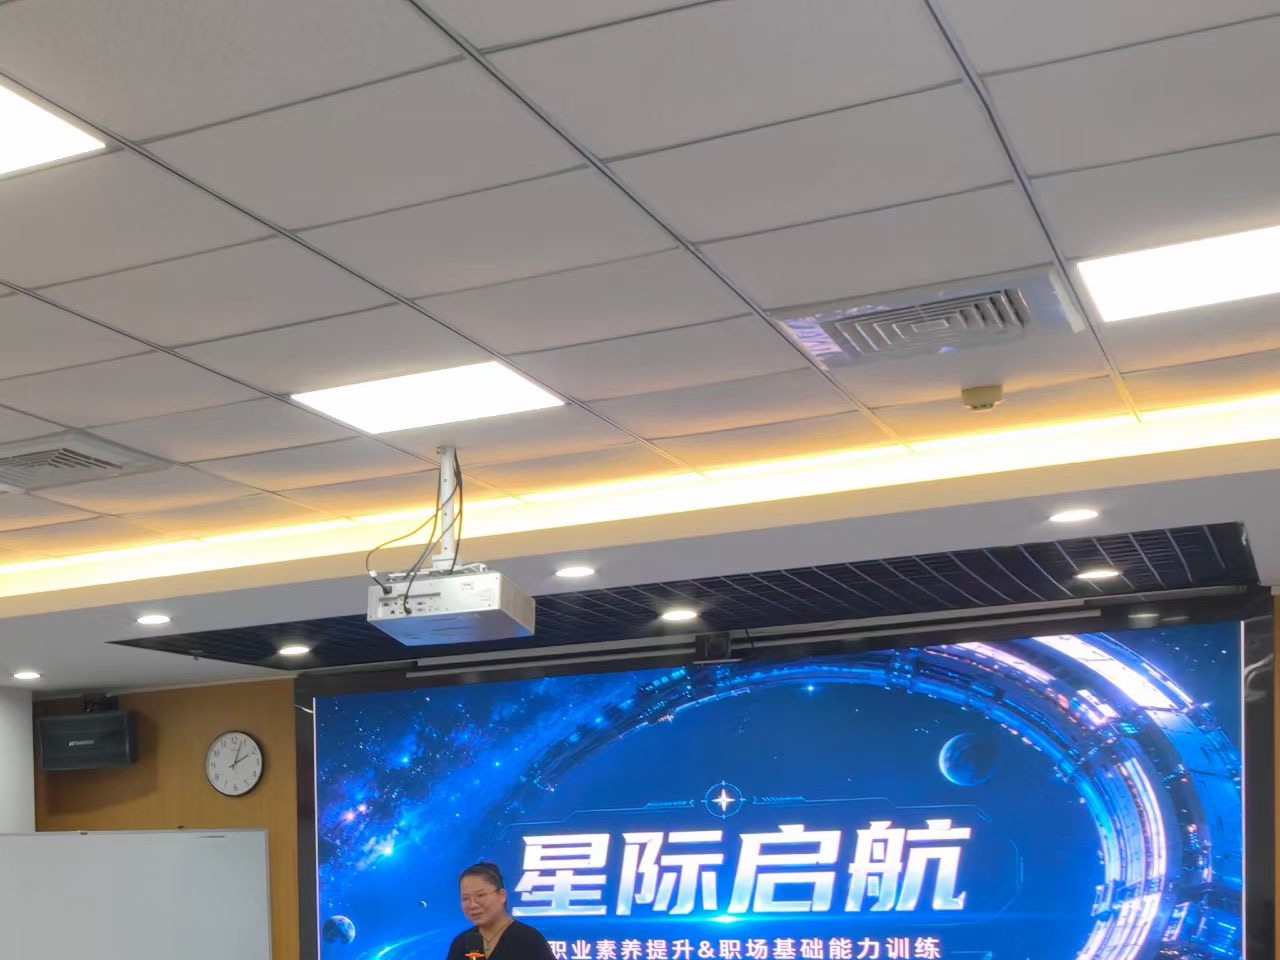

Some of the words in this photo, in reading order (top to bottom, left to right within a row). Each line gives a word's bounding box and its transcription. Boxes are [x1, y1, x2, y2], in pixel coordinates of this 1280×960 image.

[511, 818, 972, 916] 星际启航
[548, 937, 942, 960] 职业素养提升&职场基础能力训练
